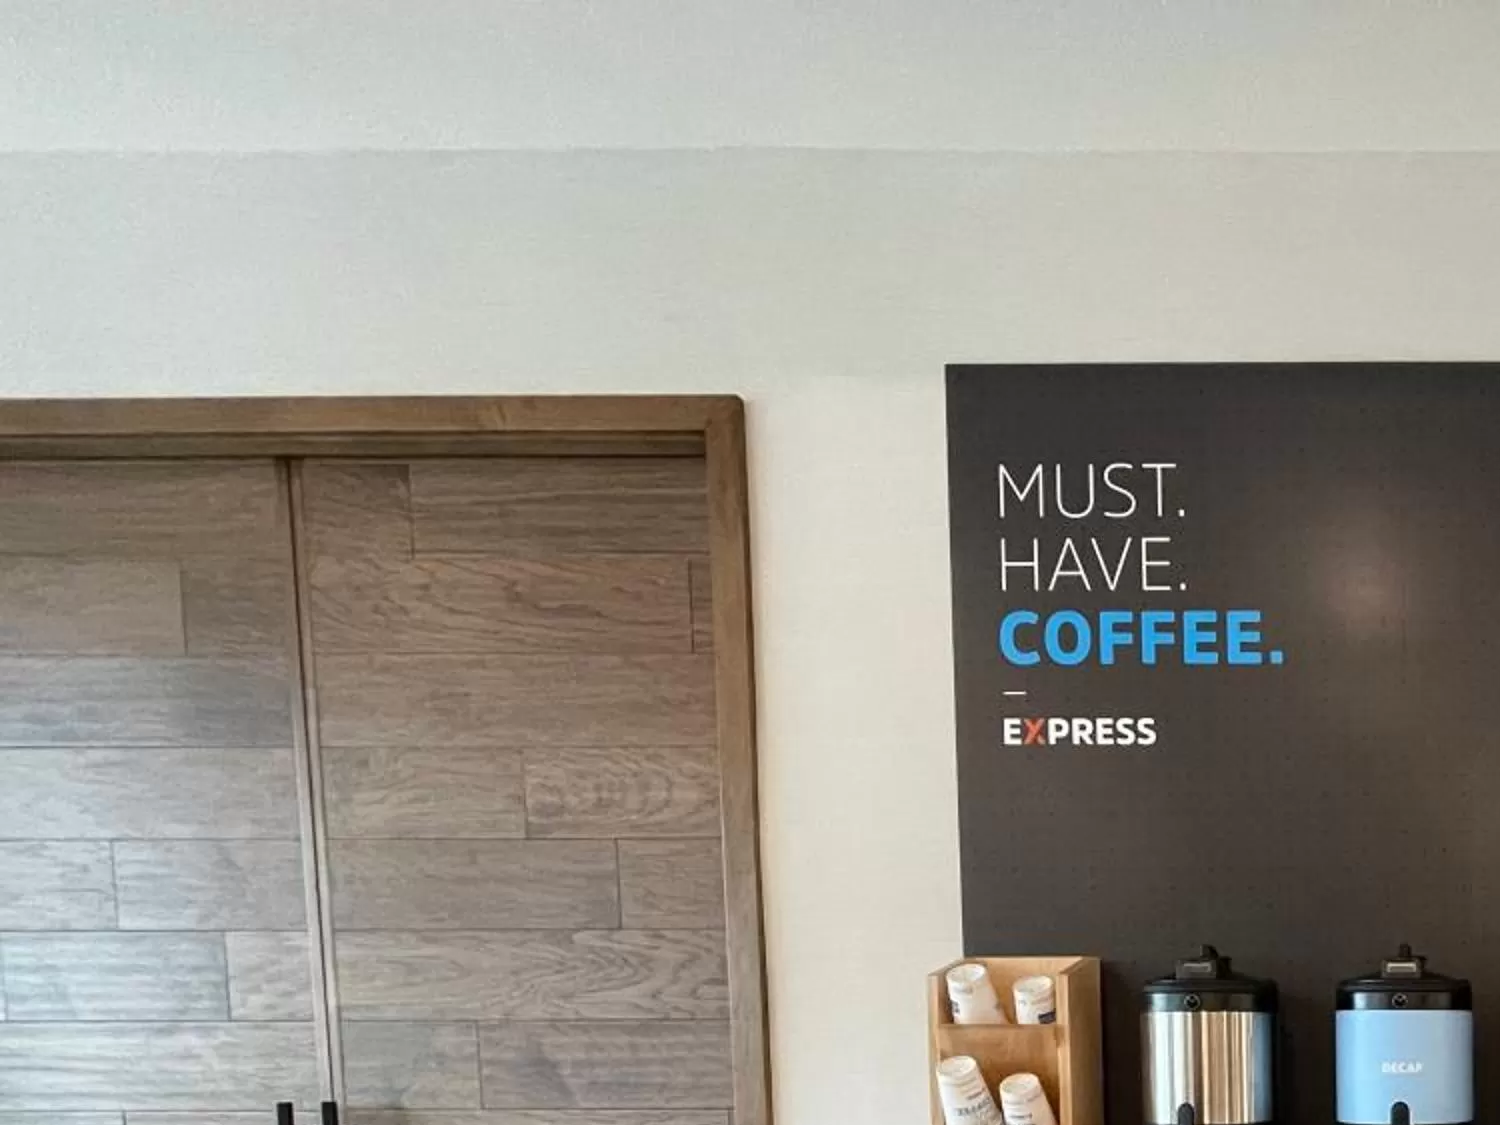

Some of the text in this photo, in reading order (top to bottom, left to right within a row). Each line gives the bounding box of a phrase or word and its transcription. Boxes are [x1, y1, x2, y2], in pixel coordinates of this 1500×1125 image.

[998, 463, 1185, 518] MUST.
[1000, 536, 1187, 591] HAVE.
[999, 609, 1284, 665] COFFEE.
[1002, 718, 1157, 745] EXPRESS
